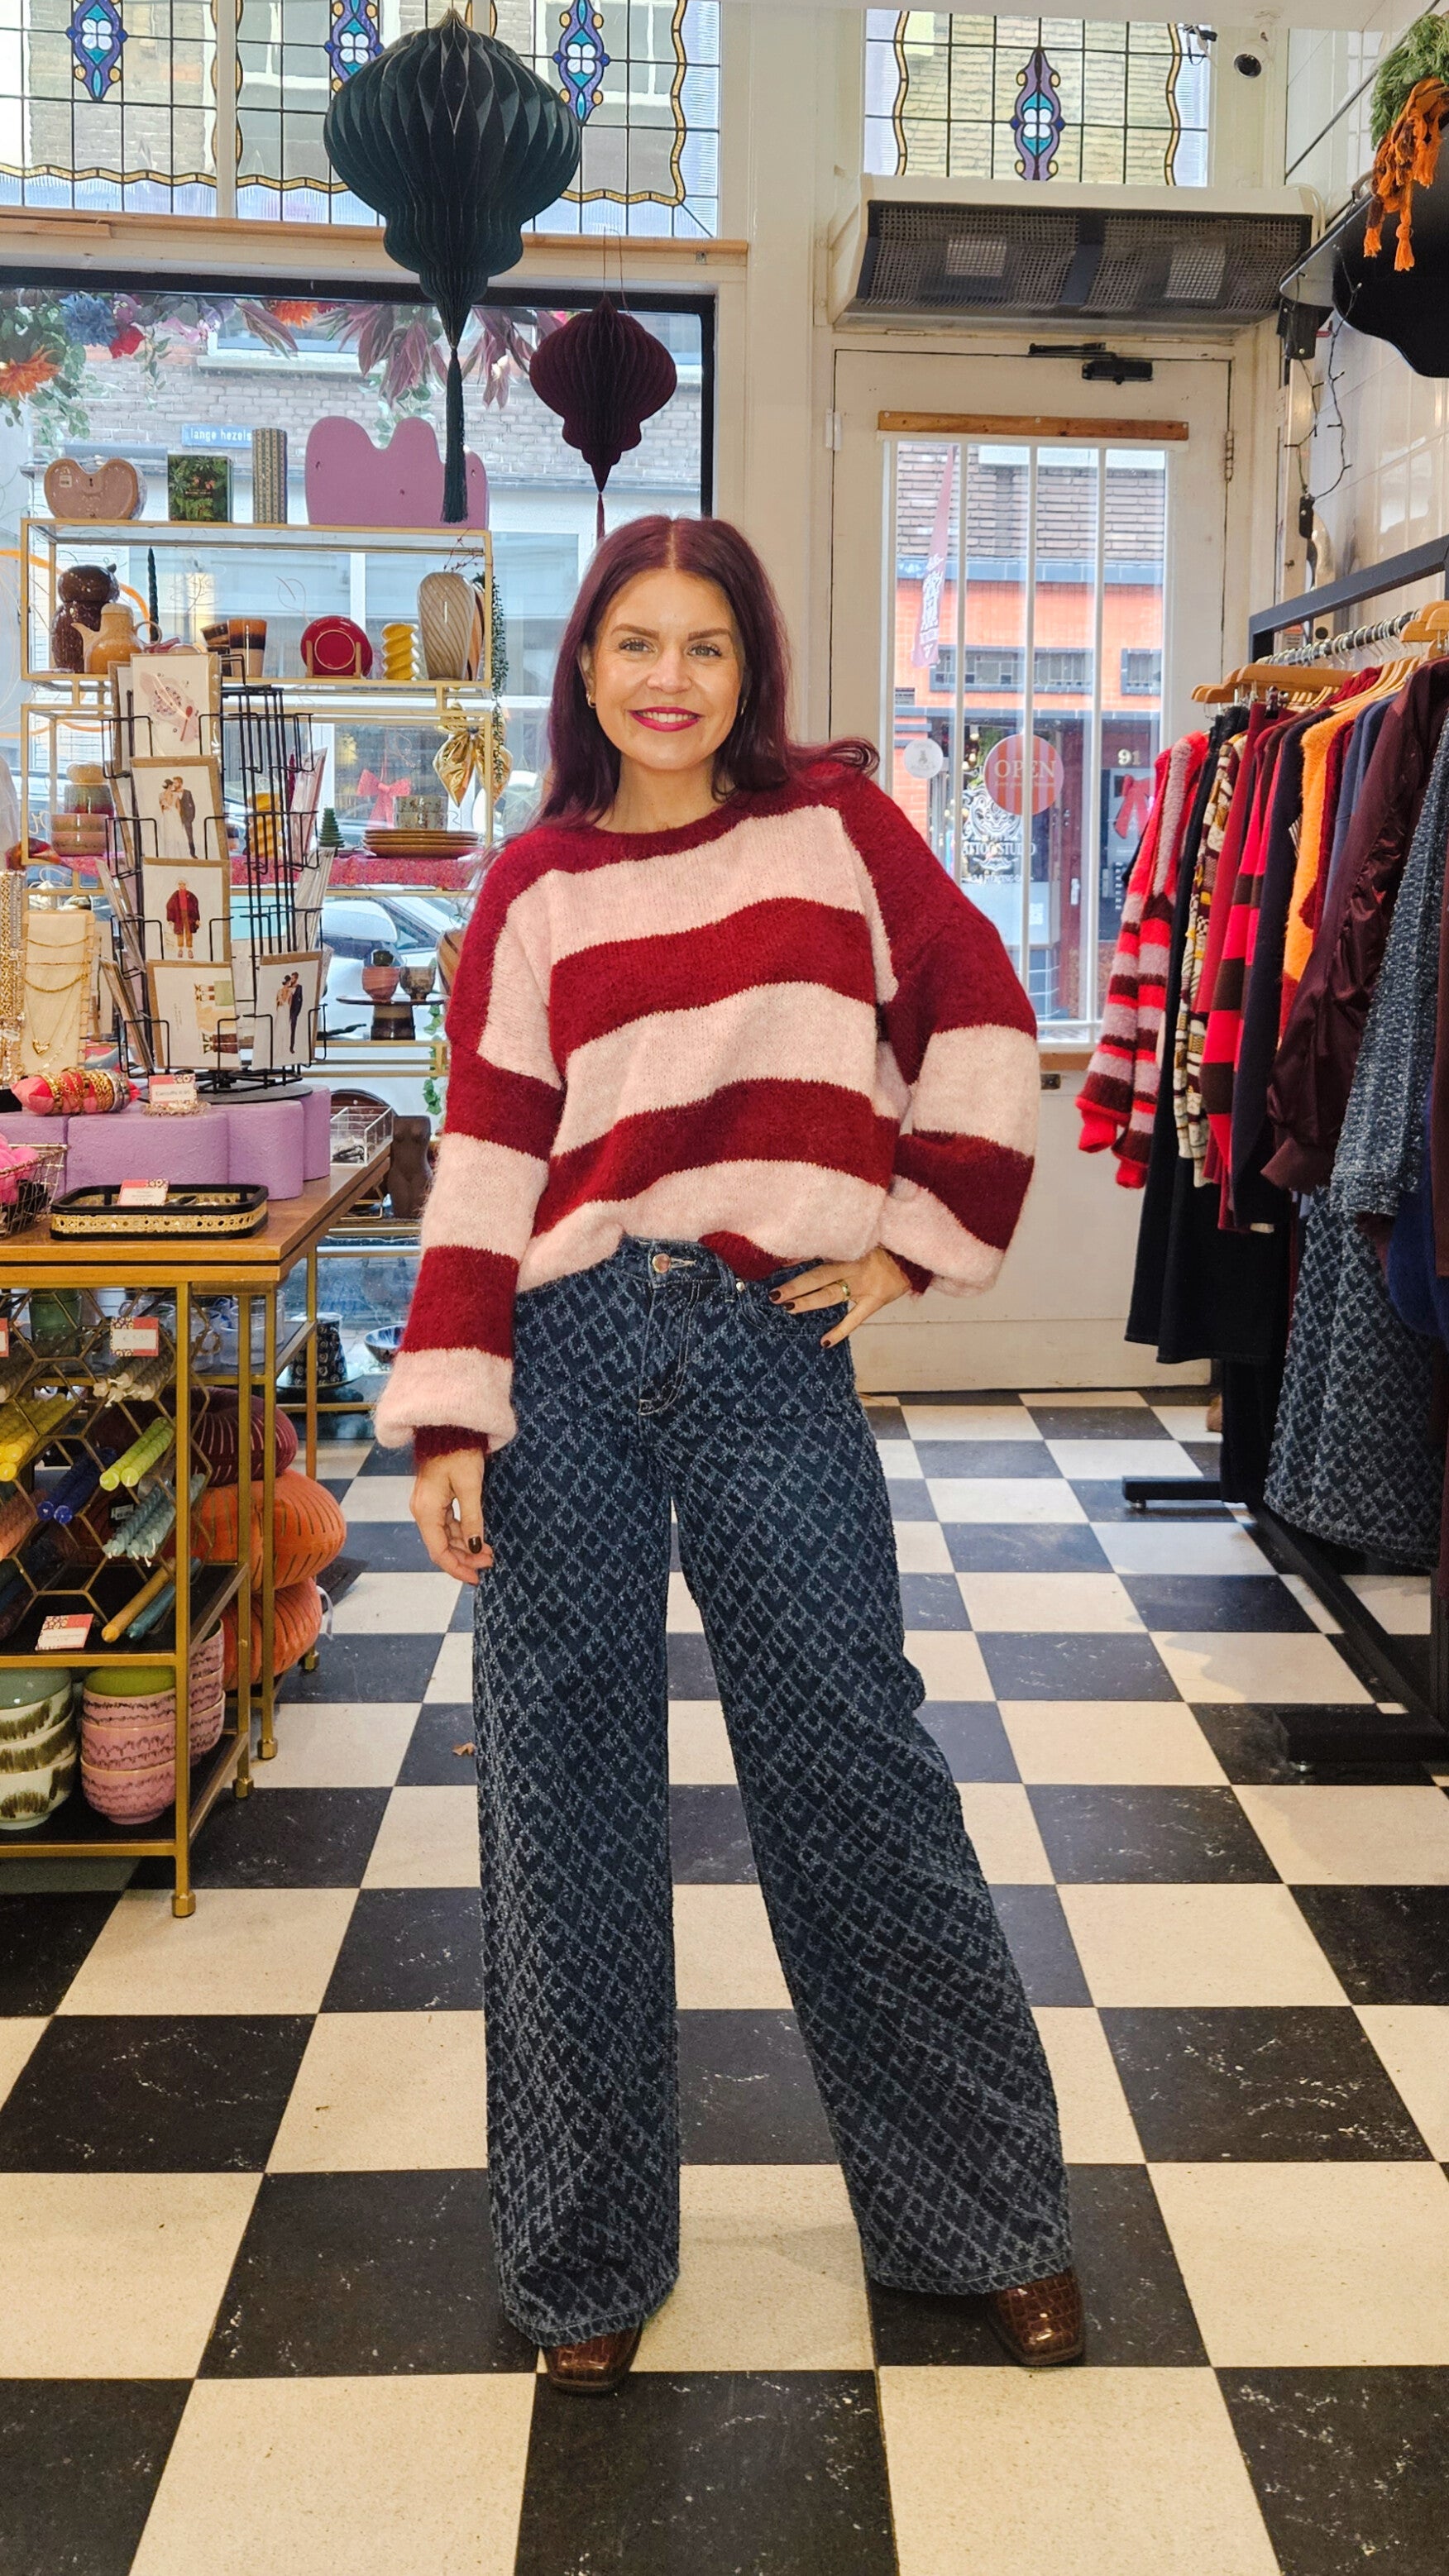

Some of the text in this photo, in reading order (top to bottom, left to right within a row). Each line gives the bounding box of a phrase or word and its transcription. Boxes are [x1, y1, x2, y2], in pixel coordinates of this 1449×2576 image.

[190, 428, 252, 442] lange hezels
[1118, 748, 1141, 765] 91
[995, 760, 1056, 778] OPEN
